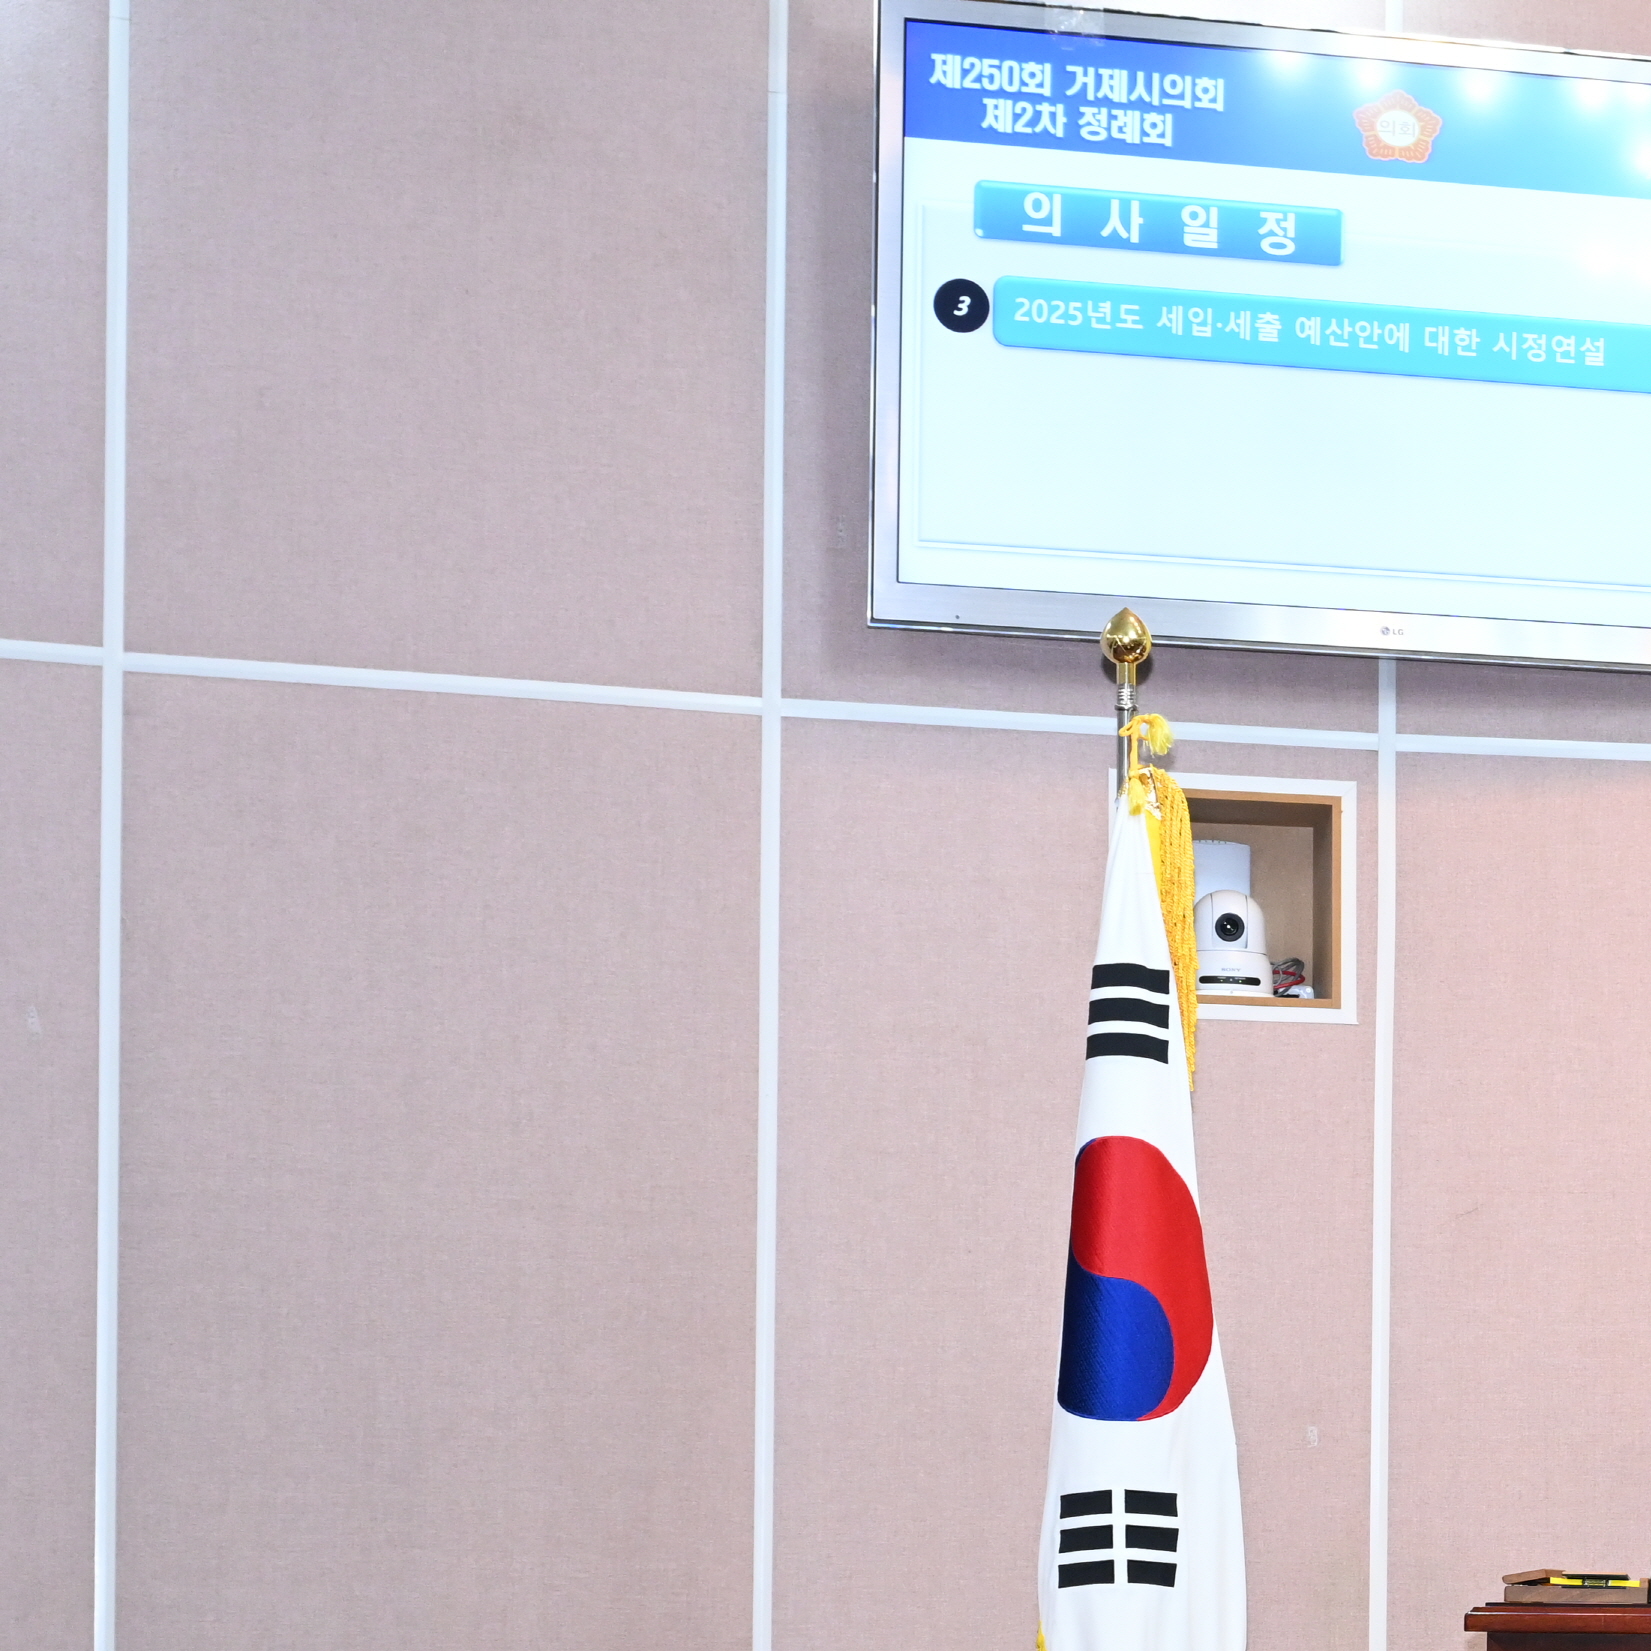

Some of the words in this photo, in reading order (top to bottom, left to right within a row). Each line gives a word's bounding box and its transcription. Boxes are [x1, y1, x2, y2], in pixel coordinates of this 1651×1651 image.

[929, 53, 1051, 97] 제250회
[1065, 65, 1225, 111] 거제시의회
[981, 98, 1067, 138] 제2차
[1078, 106, 1172, 147] 정례회
[953, 295, 971, 317] 3
[1013, 297, 1144, 330] 2025년도
[1295, 316, 1410, 353] 예산안에
[1424, 326, 1481, 357] 대한
[1492, 331, 1606, 366] 시정연설
